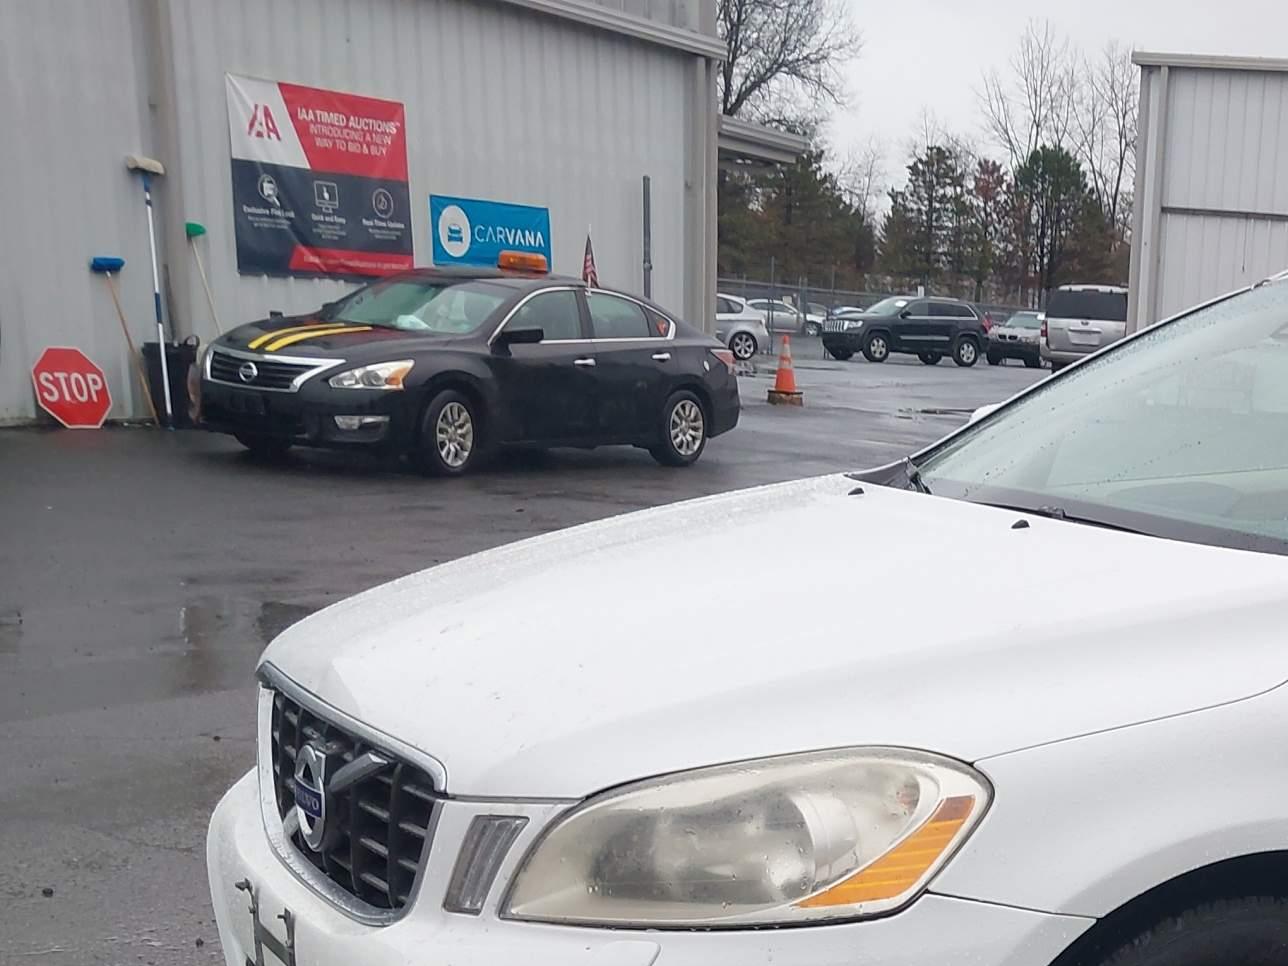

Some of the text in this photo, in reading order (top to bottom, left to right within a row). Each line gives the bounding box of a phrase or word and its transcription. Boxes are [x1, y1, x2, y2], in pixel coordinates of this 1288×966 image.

[297, 107, 315, 123] IAA
[315, 110, 347, 127] TIMED
[309, 124, 392, 145] INTRODUCING A NEW
[315, 137, 388, 157] WAY TO BID & BUY
[474, 225, 545, 247] CARVANA
[39, 372, 103, 402] STOP
